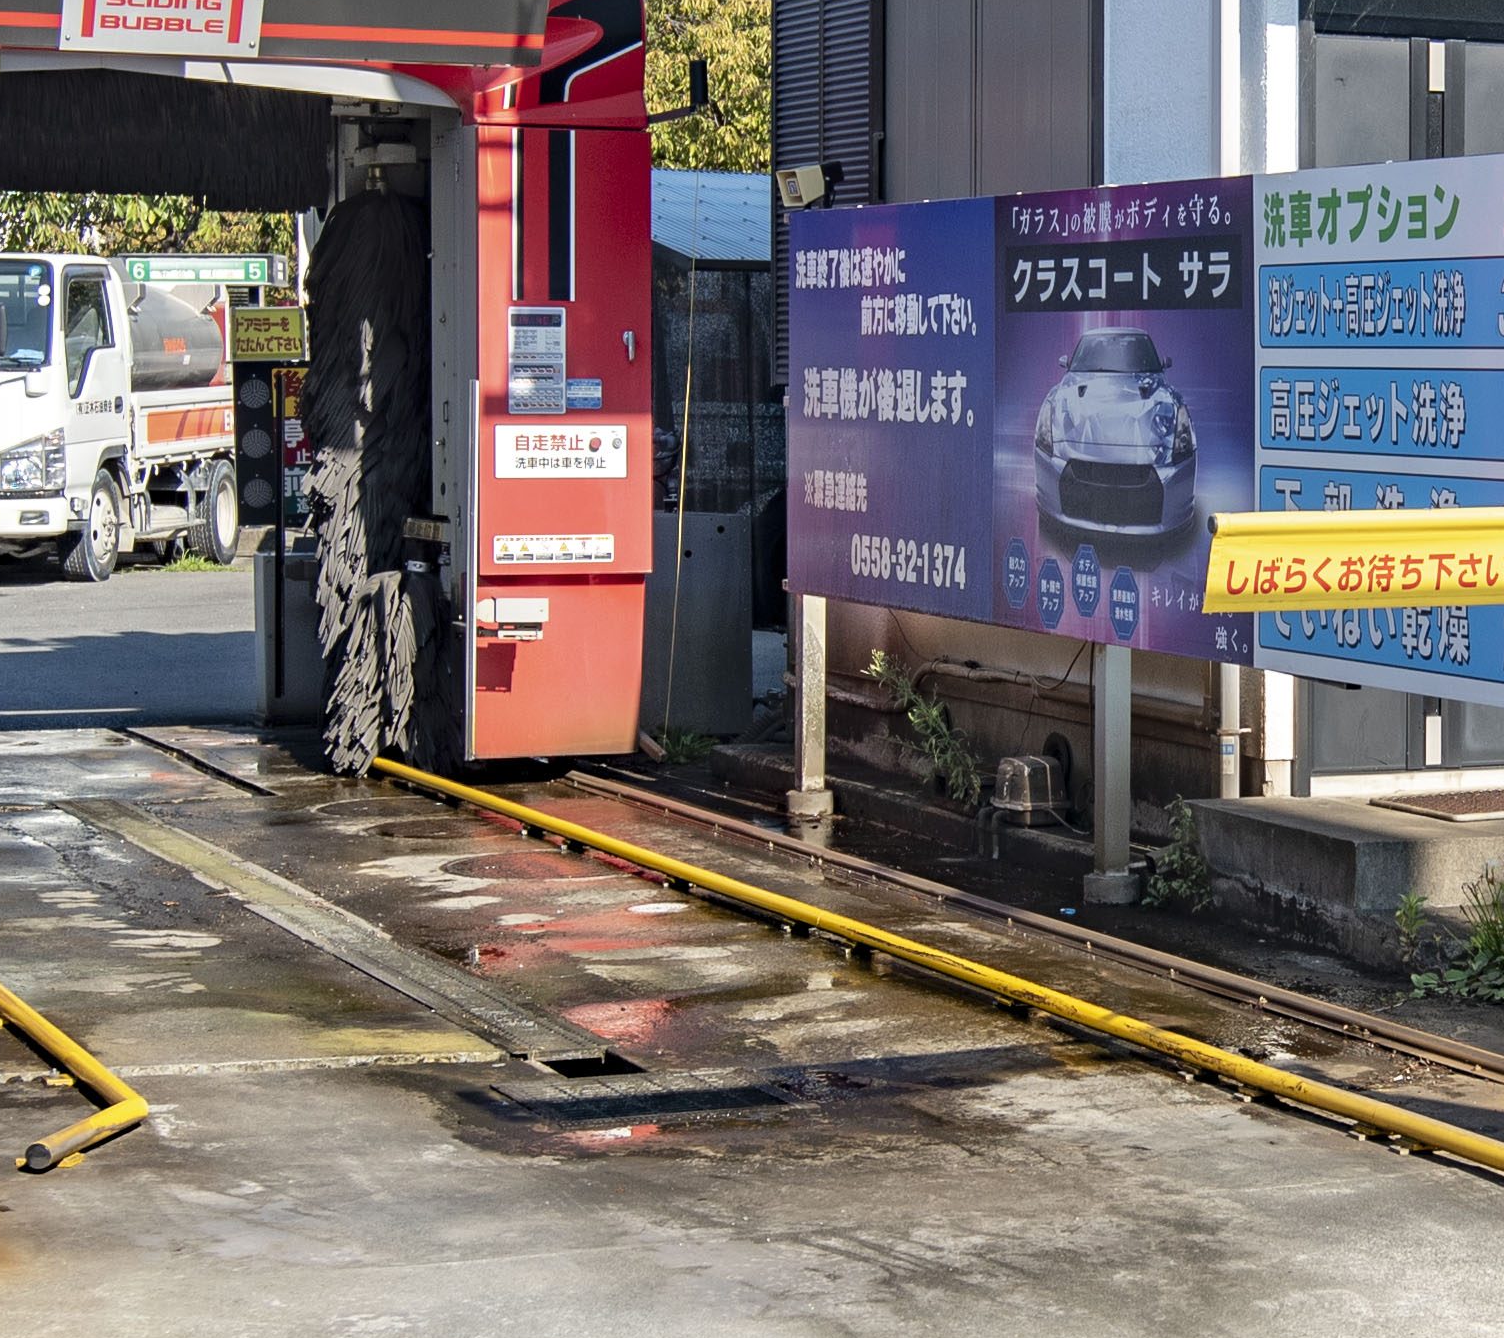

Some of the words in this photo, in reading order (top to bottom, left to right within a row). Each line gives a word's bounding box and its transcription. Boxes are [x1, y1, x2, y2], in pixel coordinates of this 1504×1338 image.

[99, 14, 224, 34] BUBBLE
[1012, 194, 1231, 236] 「ガラス」の被膜がボディを守る。
[1264, 183, 1459, 248] 洗車オプション
[133, 263, 144, 278] 6
[249, 263, 261, 278] 5
[796, 246, 906, 289] 洗車終了後は速やかに
[1013, 252, 1161, 302] クラスコート
[1178, 251, 1230, 299] サラ
[861, 293, 977, 336] 前方に移動して下さい。
[1268, 270, 1466, 337] 泡ジェット+高圧ジェット洗浄
[235, 317, 289, 332] ドアミラーを
[235, 336, 302, 353] たたんで下さい
[803, 366, 974, 428] 洗車機が後退します。
[1270, 378, 1467, 447] 高圧ジェット洗浄
[515, 434, 584, 452] 自走禁止
[515, 456, 606, 470] 洗車中は車を停止
[804, 469, 867, 512] ※緊急連絡先
[851, 533, 966, 590] 0558-32-1374
[1009, 574, 1025, 588] アップ
[1042, 597, 1058, 611] アップ
[1078, 590, 1095, 602] アップ
[1216, 627, 1248, 653] 強く。
